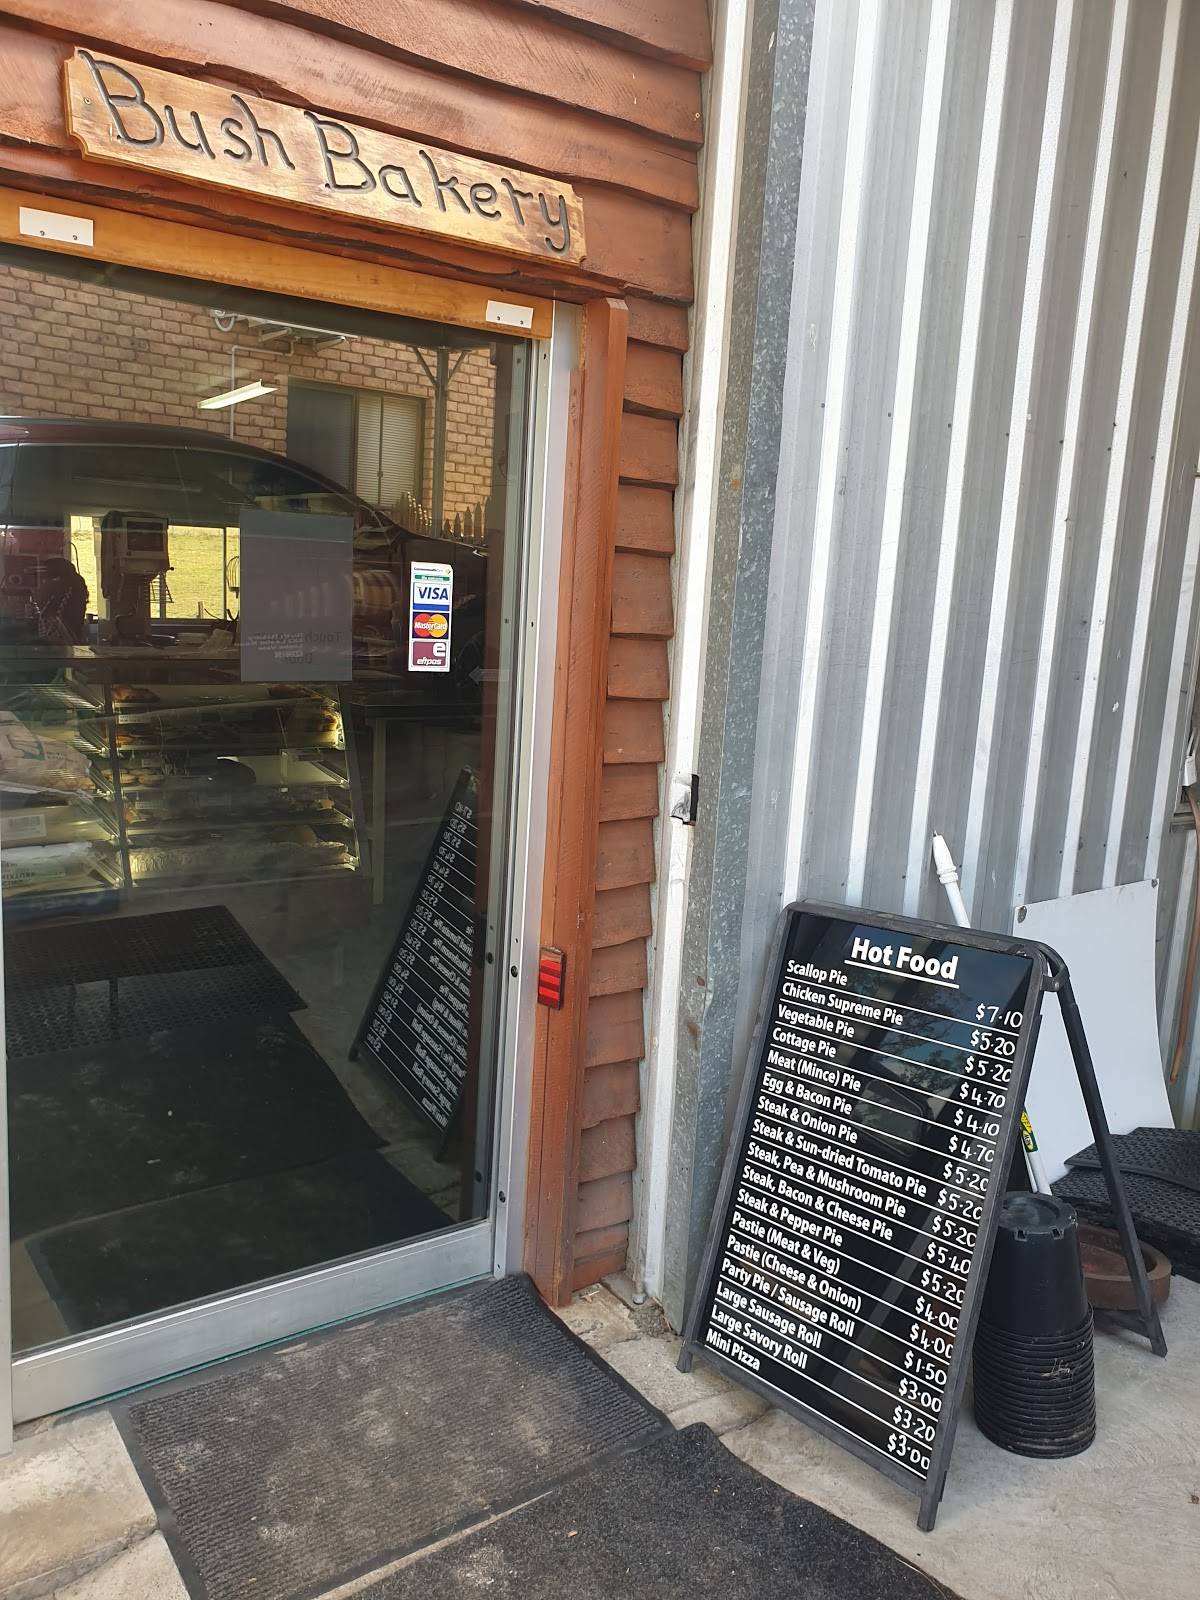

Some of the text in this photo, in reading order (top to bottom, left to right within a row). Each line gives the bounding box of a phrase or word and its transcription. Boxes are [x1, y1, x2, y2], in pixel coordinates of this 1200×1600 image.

[77, 48, 571, 256] Bush Bakery
[417, 586, 448, 600] VISA
[414, 620, 448, 631] MasterCard
[786, 959, 827, 982] Scallop
[828, 969, 847, 985] Pie
[851, 937, 959, 980] Hot Food
[778, 1004, 833, 1031] Vegetable
[835, 1019, 854, 1037] Pie
[782, 982, 825, 1004] Chicken
[826, 993, 881, 1019] Supreme
[882, 1007, 902, 1025] Pie
[772, 1027, 816, 1052] Cottage
[817, 1040, 836, 1057] Pie
[762, 1072, 784, 1093] Egg
[784, 1080, 794, 1094] &
[795, 1083, 830, 1107] Bacon
[832, 1096, 851, 1114] Pie
[767, 1049, 796, 1070] Meat
[797, 1058, 839, 1086] (Mince)
[841, 1072, 860, 1091] Pie
[757, 1095, 789, 1118] Steak
[789, 1107, 799, 1122] &
[801, 1111, 836, 1135] Onion
[838, 1124, 857, 1143] Pie
[747, 1142, 780, 1168] Steak,
[782, 1155, 803, 1176] Pea
[805, 1165, 815, 1180] &
[816, 1169, 882, 1208] Mushroom
[884, 1196, 905, 1217] Pie
[752, 1118, 783, 1142] Steak
[784, 1131, 794, 1146] &
[795, 1135, 854, 1169] Sun-dried
[856, 1156, 902, 1187] Tomato
[904, 1176, 926, 1197] Pie
[737, 1188, 768, 1213] Steak
[769, 1202, 778, 1218] &
[779, 1206, 822, 1236] Pepper
[822, 1225, 842, 1246] Pie
[742, 1165, 775, 1192] Steak,
[777, 1179, 812, 1206] Bacon
[814, 1195, 824, 1211] &
[826, 1200, 870, 1230] Cheese
[871, 1218, 892, 1240] Pie
[732, 1211, 765, 1238] Pastie
[766, 1227, 800, 1254] (Meat
[800, 1243, 811, 1259] &
[813, 1247, 839, 1274] Veg)
[721, 1257, 751, 1285] Party
[752, 1272, 770, 1293] Pie
[770, 1283, 778, 1296] /
[777, 1286, 827, 1322] Sausage
[828, 1311, 854, 1336] Roll
[727, 1234, 760, 1261] Pastie
[761, 1251, 805, 1284] (Cheese
[806, 1273, 817, 1290] &
[818, 1279, 861, 1313] Onion)
[711, 1304, 741, 1332] Large
[742, 1322, 782, 1356] Savory
[782, 1343, 807, 1368] Roll
[716, 1280, 747, 1308] Large
[748, 1298, 795, 1334] Sausage
[796, 1323, 822, 1348] Roll
[706, 1328, 731, 1352] Mini
[731, 1342, 760, 1370] Pizza
